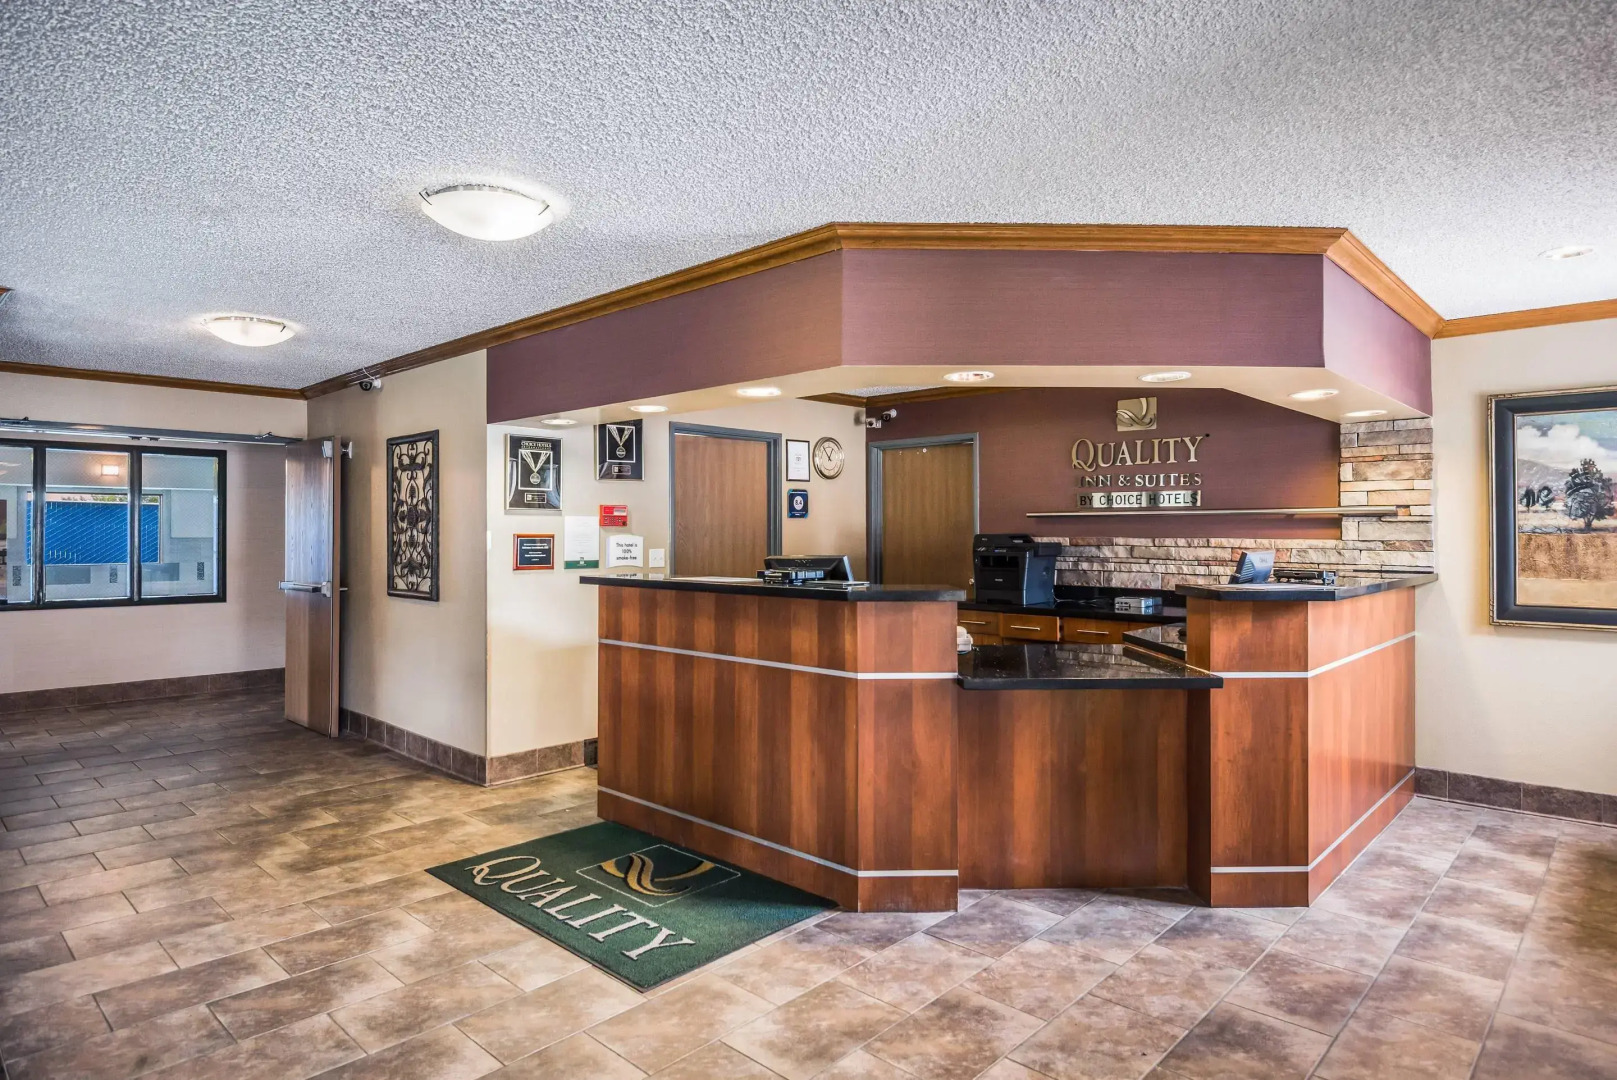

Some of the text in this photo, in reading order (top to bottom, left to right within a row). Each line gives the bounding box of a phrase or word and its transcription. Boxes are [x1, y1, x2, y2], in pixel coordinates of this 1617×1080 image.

[1071, 436, 1203, 472] QUALITY
[1080, 473, 1202, 487] INN & SUITES
[1079, 492, 1198, 506] BY CHOICE HOTELS
[464, 855, 696, 960] QUALITY
